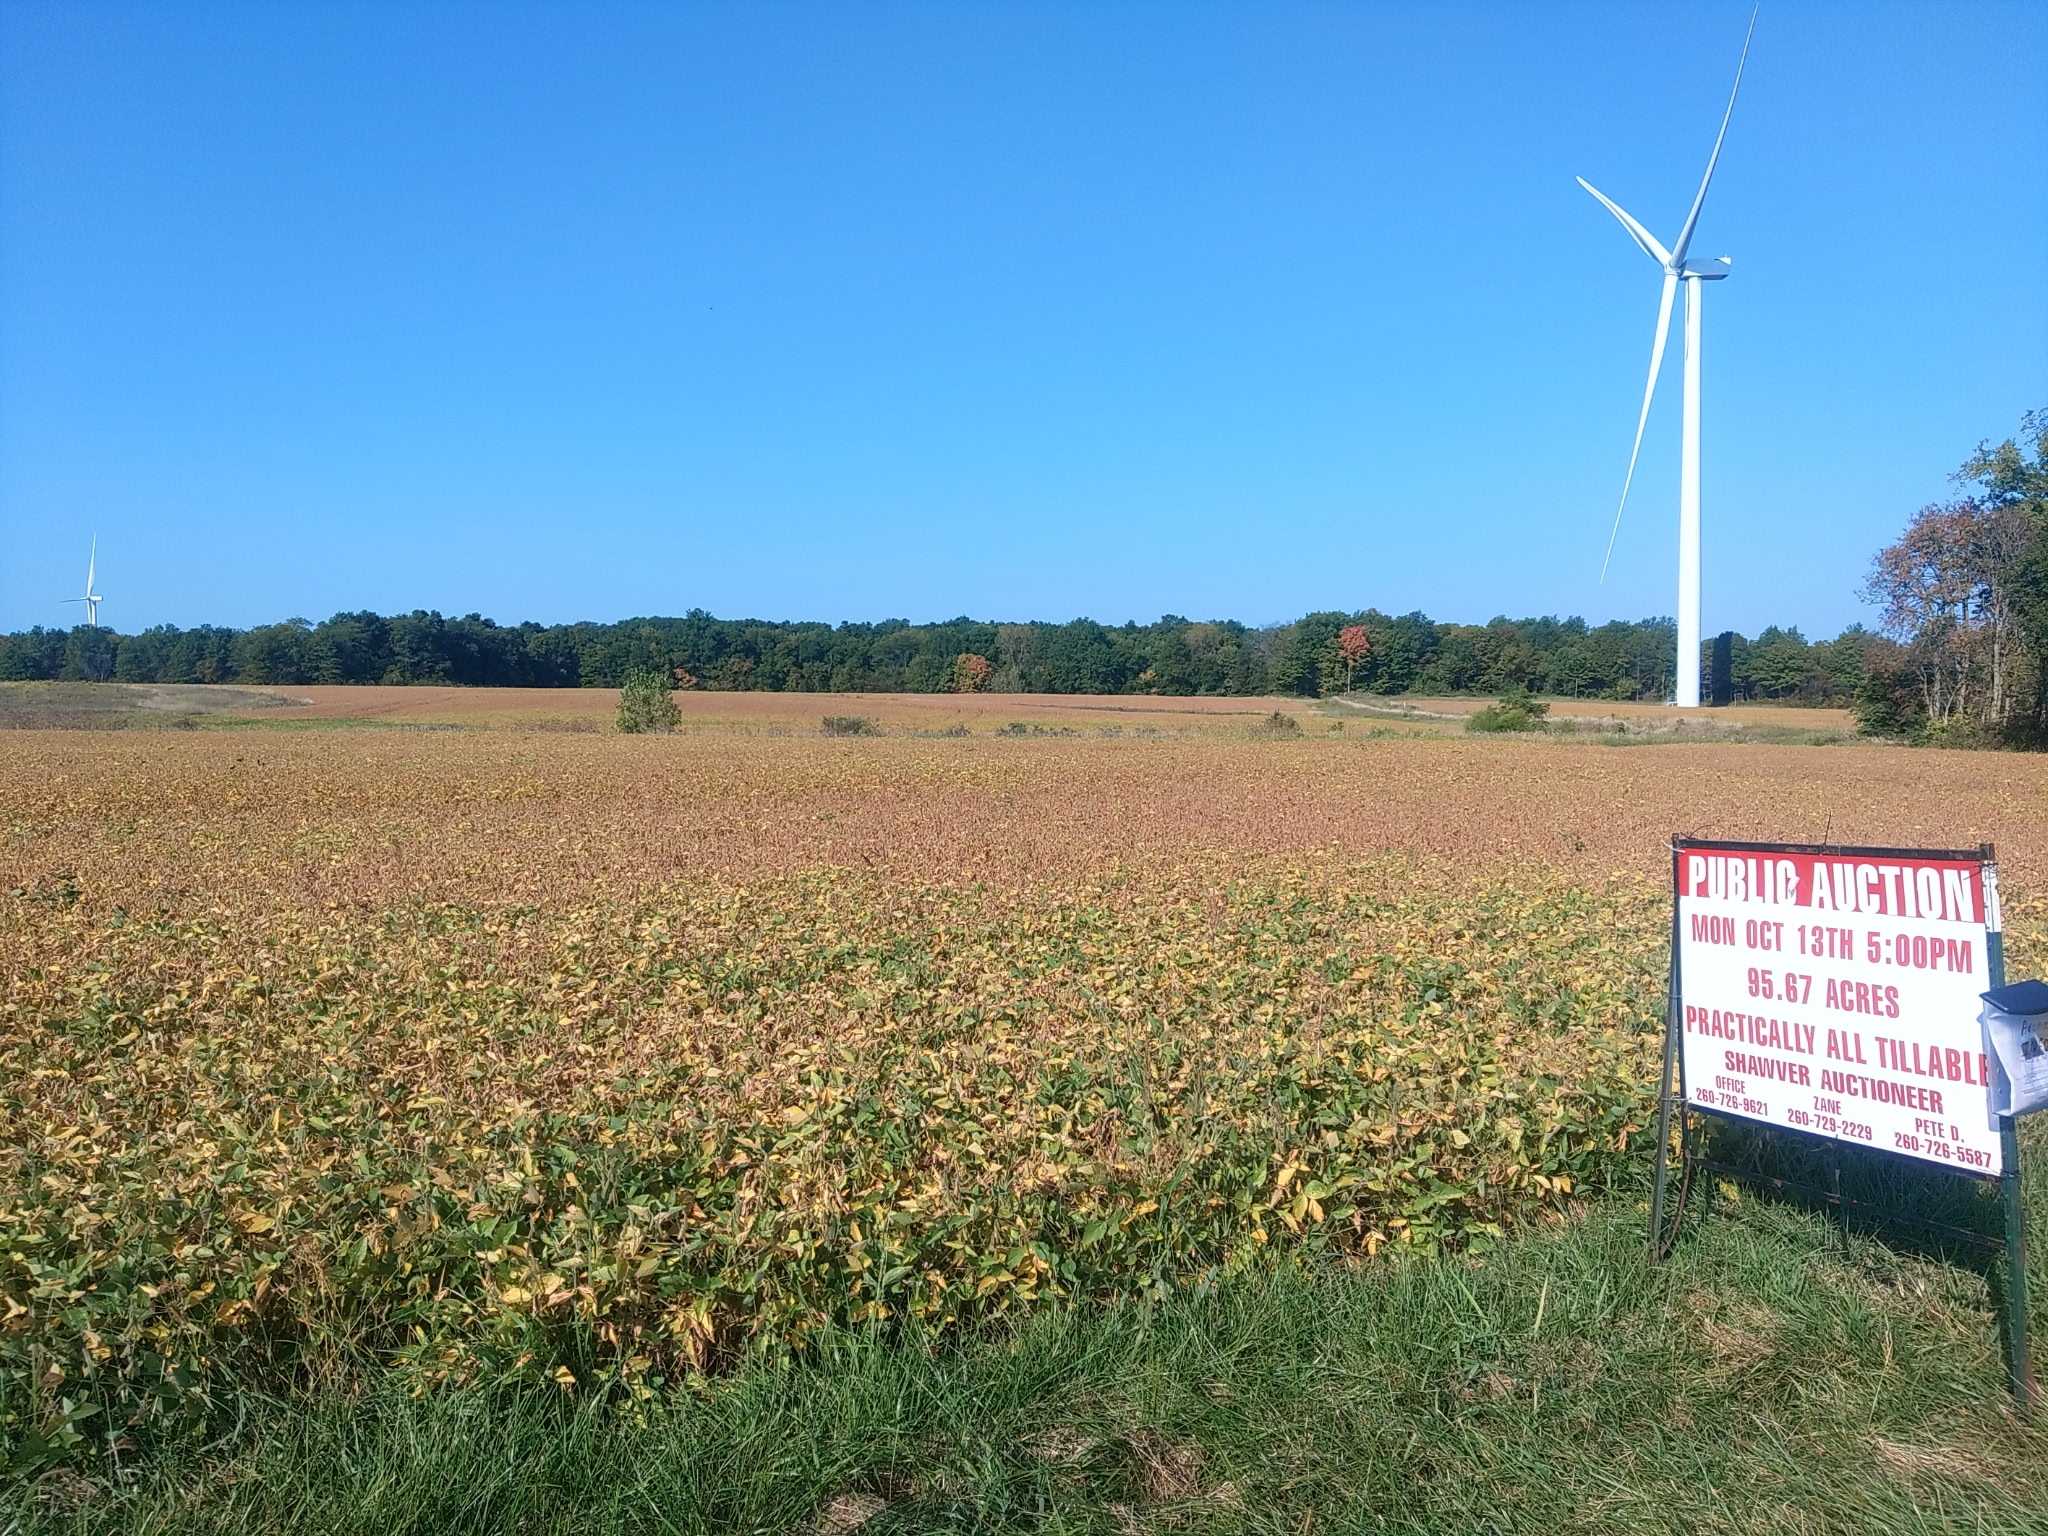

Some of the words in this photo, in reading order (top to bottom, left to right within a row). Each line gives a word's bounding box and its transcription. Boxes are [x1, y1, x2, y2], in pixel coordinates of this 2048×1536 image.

[1688, 855, 1800, 905] PUBLIC
[1811, 862, 1976, 922] AUCTION
[1691, 914, 1735, 946] MON
[1746, 919, 1784, 951] OCT
[1798, 925, 1854, 960] 13TH
[1867, 931, 1973, 974] 5:00PM
[1747, 968, 1812, 1005] 95.67
[1826, 978, 1900, 1018] ACRES
[1686, 1006, 1816, 1056] PRACTICALLY
[1826, 1028, 1867, 1065] ALL
[1875, 1036, 1989, 1087] TILLABLE
[1715, 1075, 1746, 1095] OFFICE
[1724, 1050, 1811, 1087] SHAWVER
[1820, 1069, 1944, 1115] AUCTIONEER
[1696, 1087, 1769, 1117] 260-726-9621
[1813, 1096, 1842, 1115] ZANE
[1787, 1108, 1873, 1141] 260-729-2229
[1915, 1118, 1945, 1139] PETE
[1950, 1125, 1965, 1143] D.
[1894, 1132, 1992, 1169] 260-726-5587
